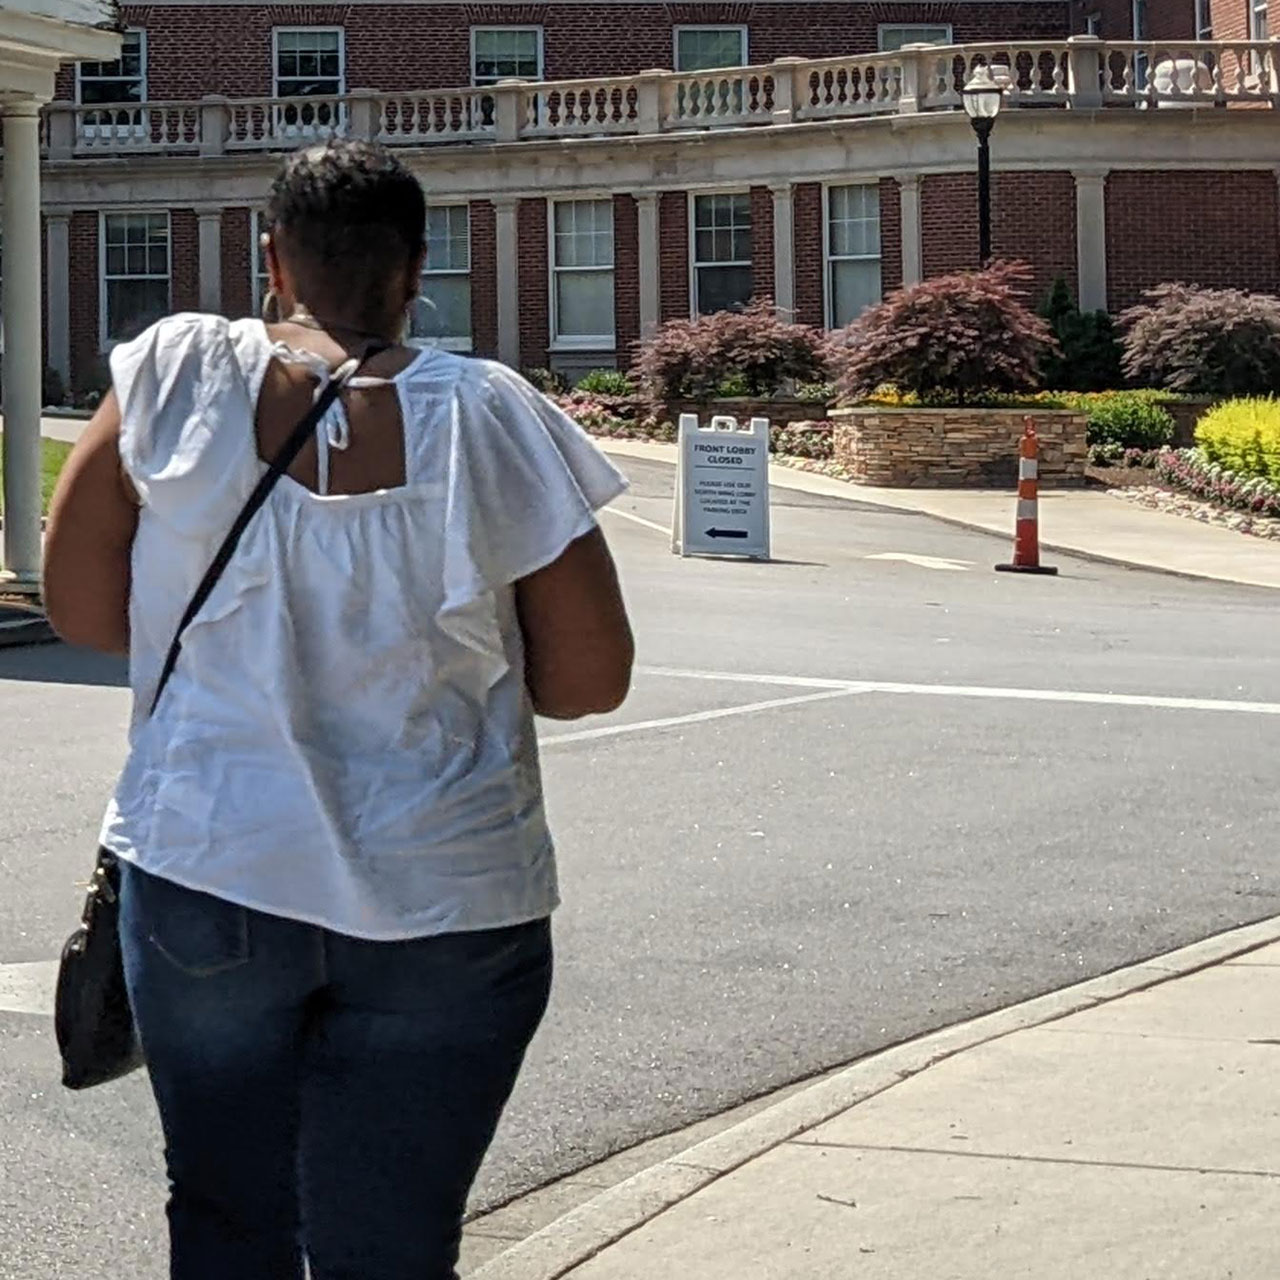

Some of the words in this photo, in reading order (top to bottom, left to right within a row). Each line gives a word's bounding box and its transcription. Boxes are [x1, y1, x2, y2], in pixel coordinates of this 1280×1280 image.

[694, 444, 726, 453] FRONT
[726, 445, 757, 455] LOBBY
[707, 455, 743, 465] CLOSED
